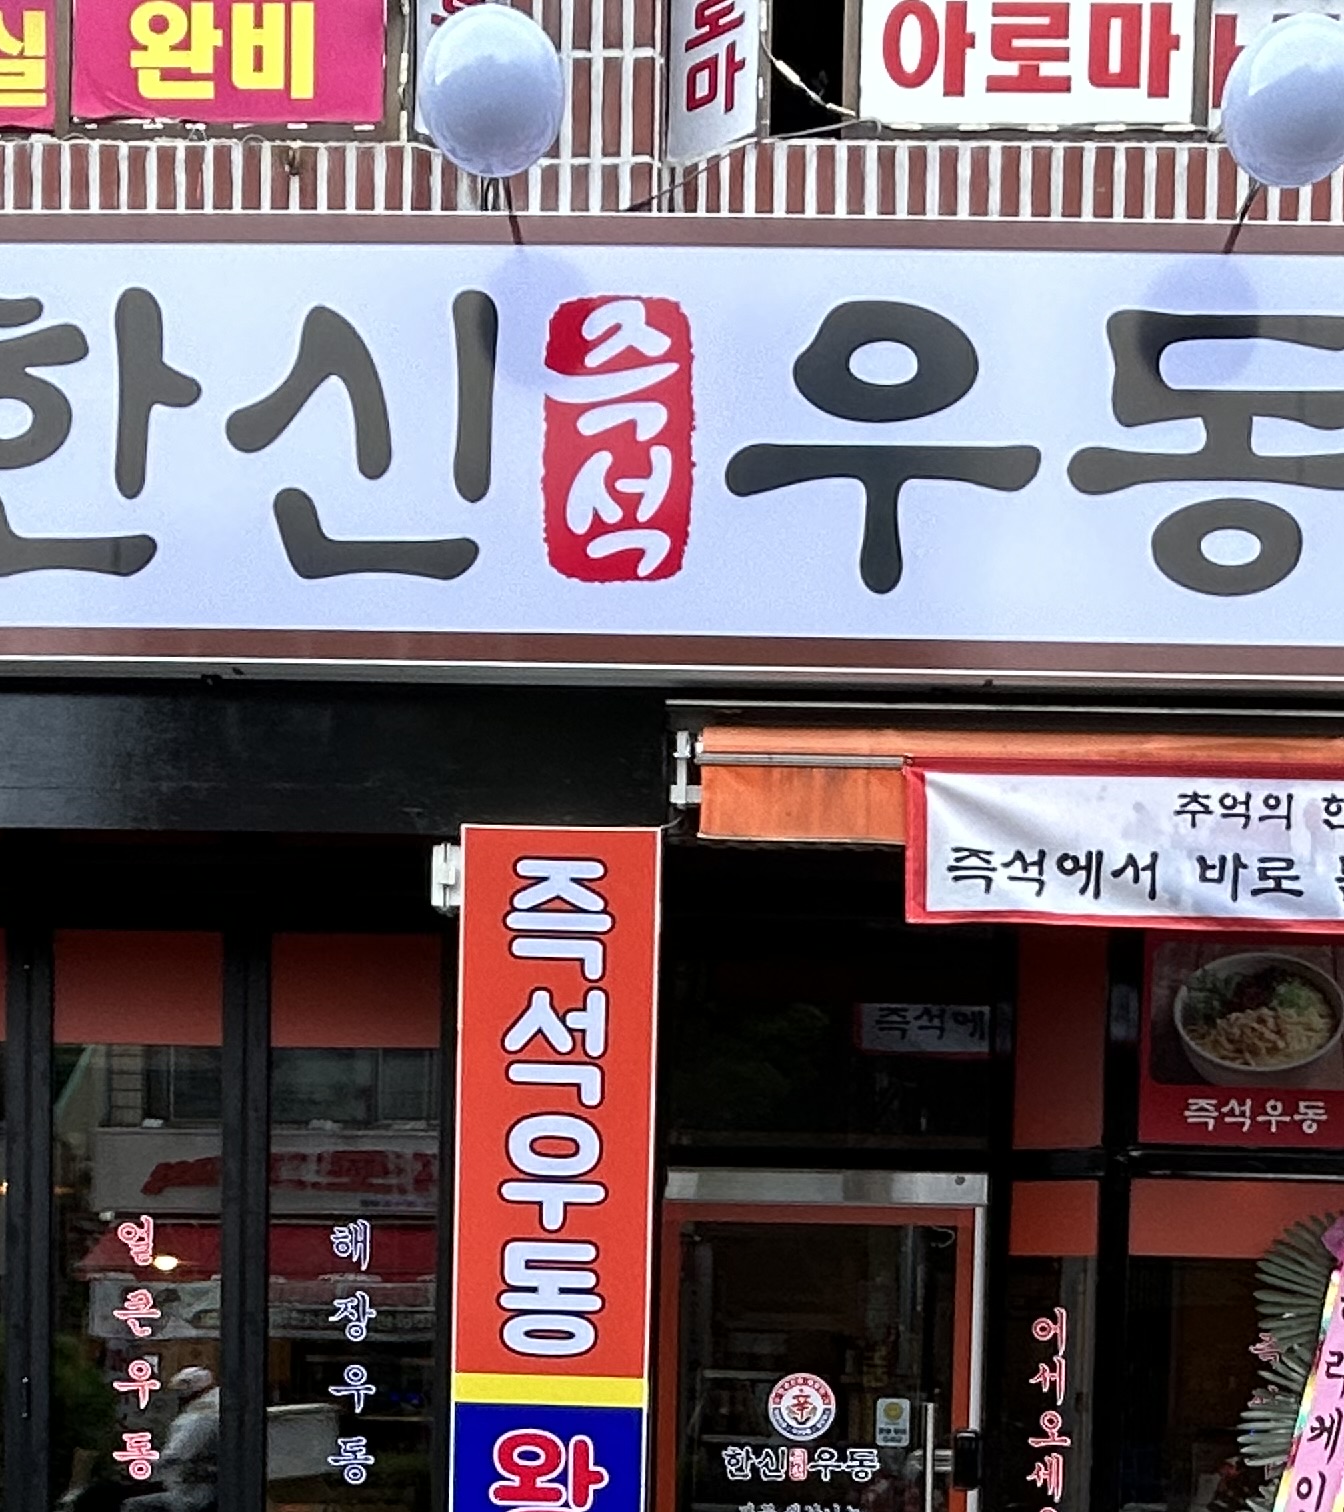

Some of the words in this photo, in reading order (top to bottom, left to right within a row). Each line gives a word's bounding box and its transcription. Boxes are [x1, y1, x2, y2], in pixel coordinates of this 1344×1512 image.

[128, 0, 316, 102] 완비
[883, 0, 1179, 98] 아로마
[544, 298, 692, 581] 즉석
[1173, 792, 1294, 831] 추억의
[946, 847, 1159, 899] 즉석에서
[1197, 854, 1305, 901] 바로
[497, 856, 616, 1358] 즉석우동
[1183, 1097, 1329, 1135] 즉석우동
[327, 1218, 377, 1486] 해장우동
